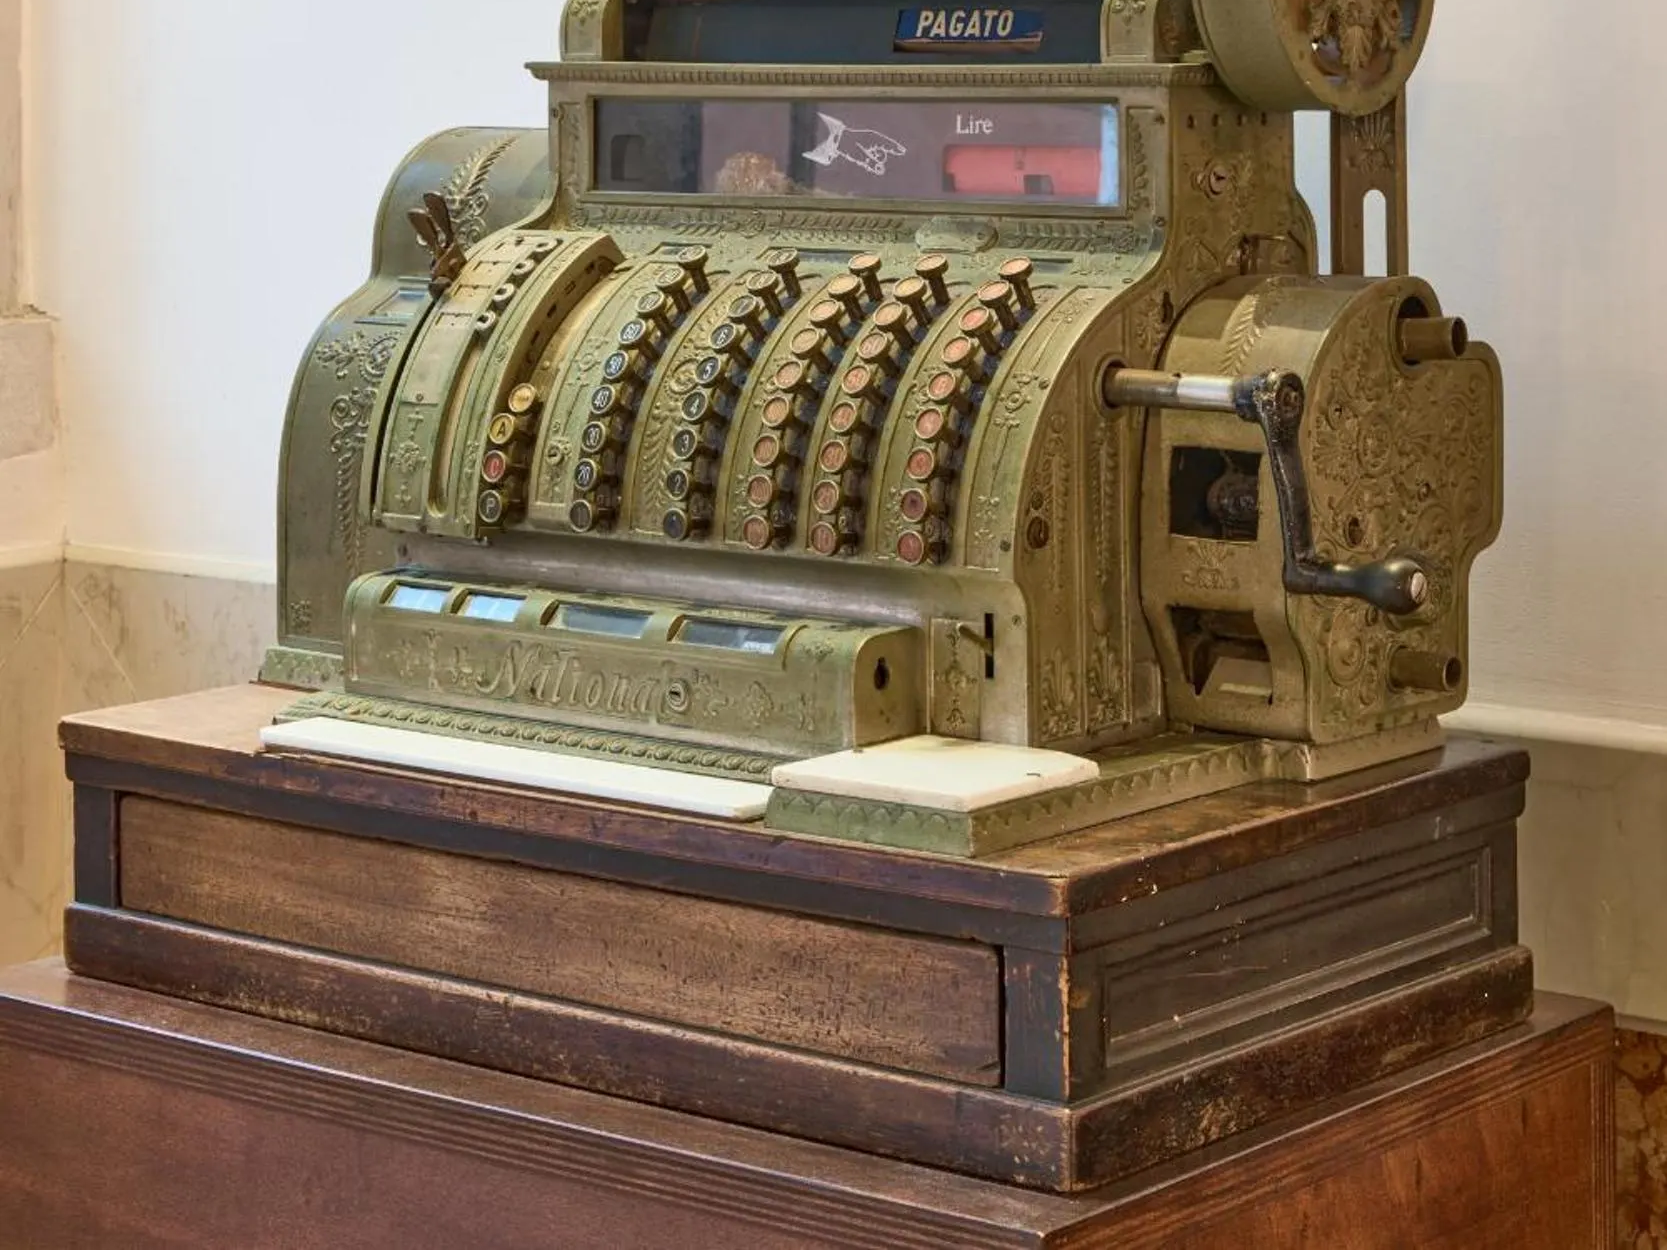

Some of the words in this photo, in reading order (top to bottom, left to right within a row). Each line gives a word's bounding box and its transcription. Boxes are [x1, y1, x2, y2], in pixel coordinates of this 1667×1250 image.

[915, 9, 1014, 38] PAGATO
[956, 113, 994, 135] Lire
[593, 387, 610, 408] 40
[496, 421, 507, 438] A
[475, 638, 676, 716] National
